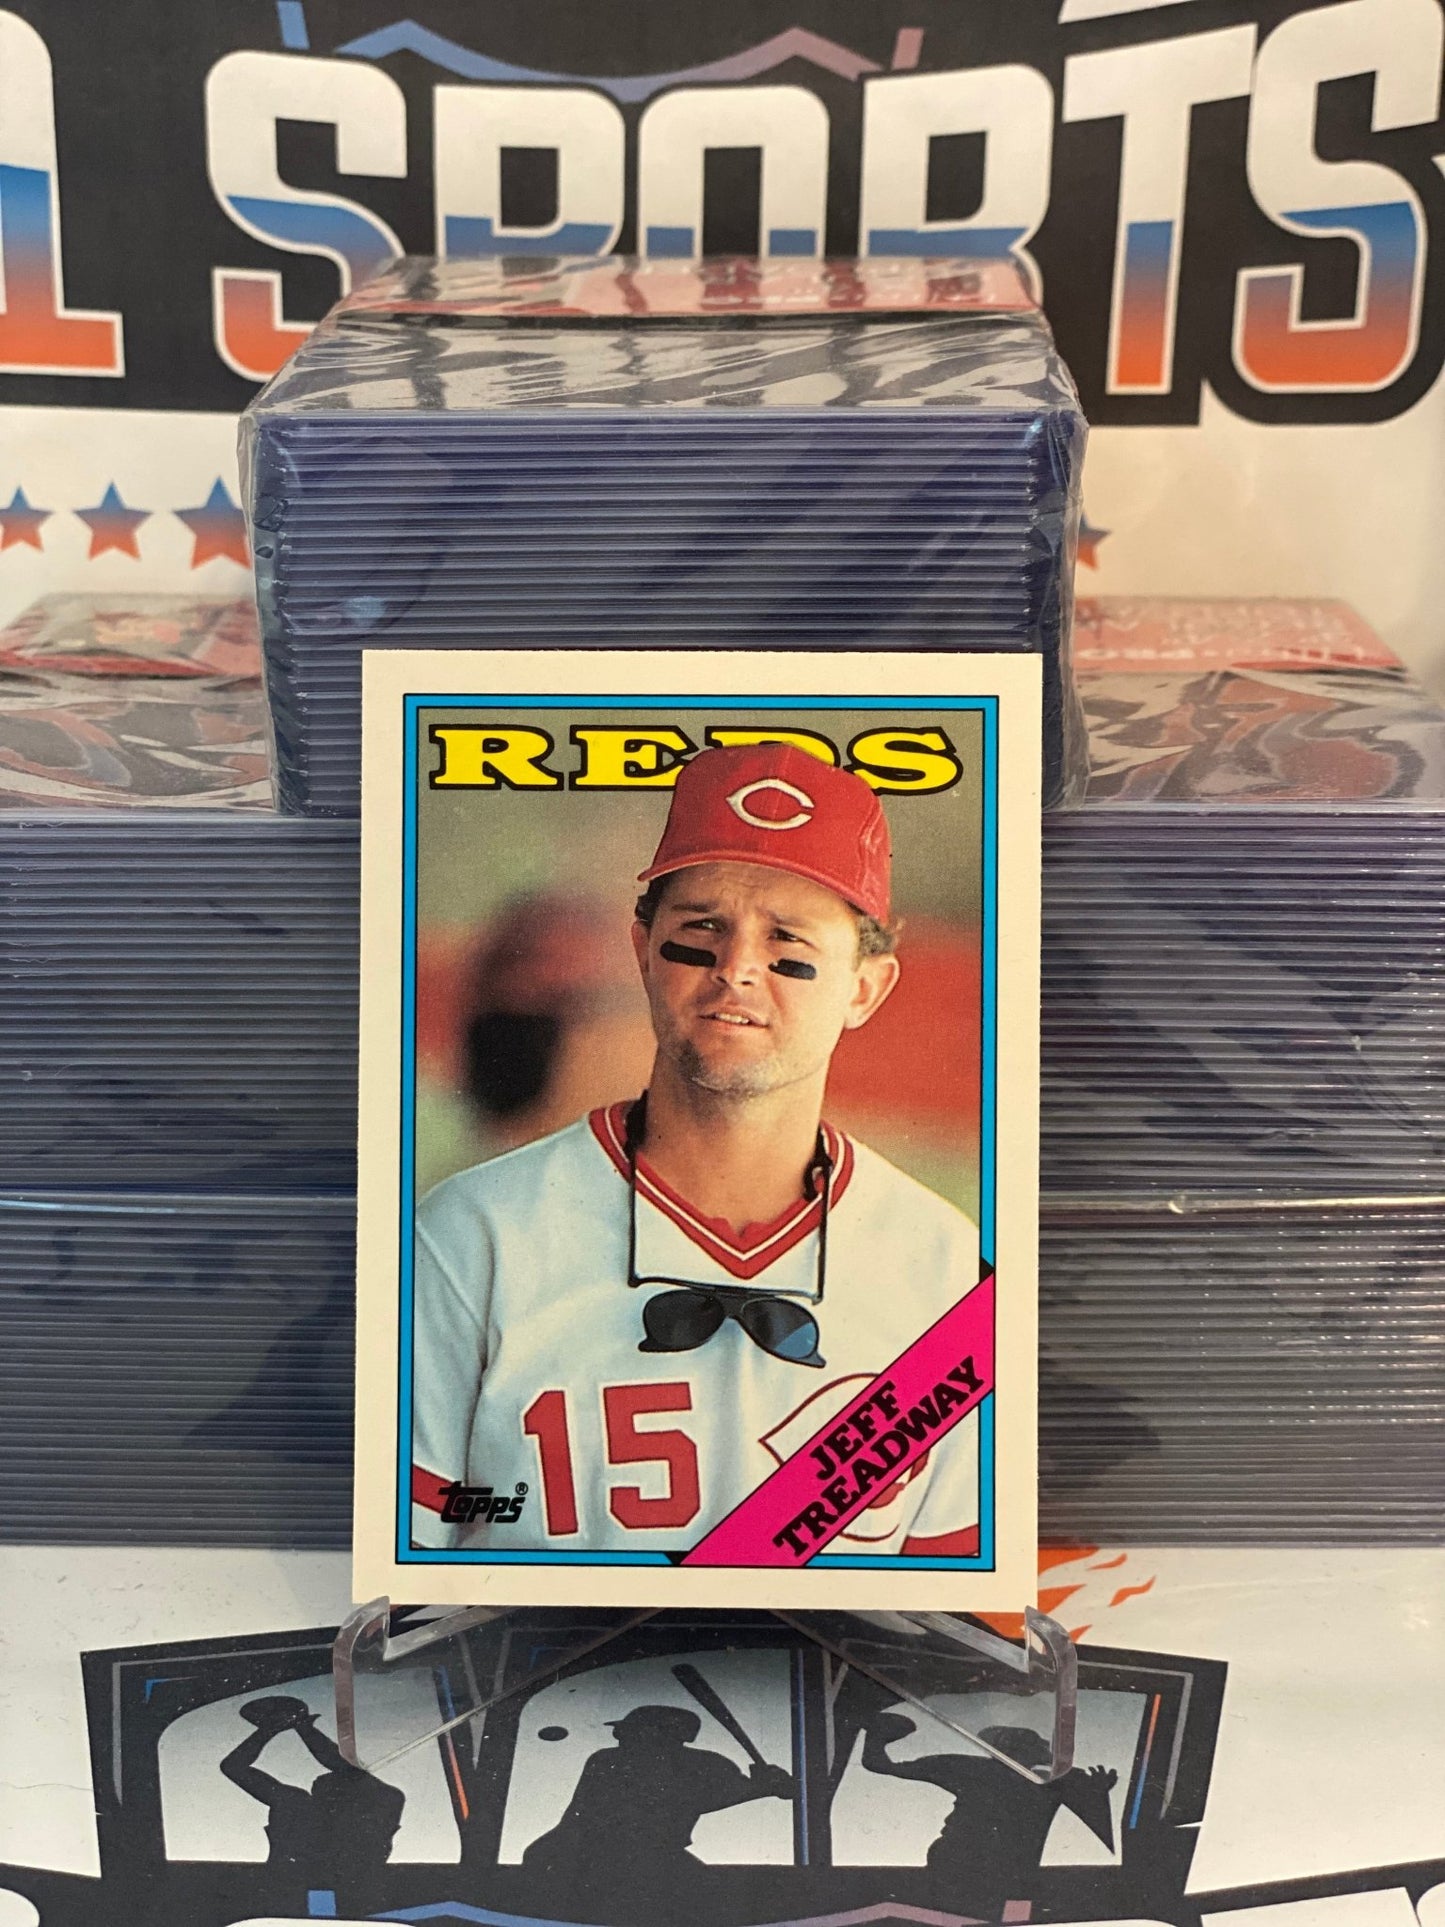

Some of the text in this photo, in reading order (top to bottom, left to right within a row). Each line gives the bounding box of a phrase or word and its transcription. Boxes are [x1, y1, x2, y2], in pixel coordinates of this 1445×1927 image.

[206, 0, 1445, 394] SPORTS
[725, 776, 815, 830] C
[523, 1381, 701, 1536] 15
[772, 1355, 985, 1557] TREADWAY
[810, 1380, 900, 1481] JEFF
